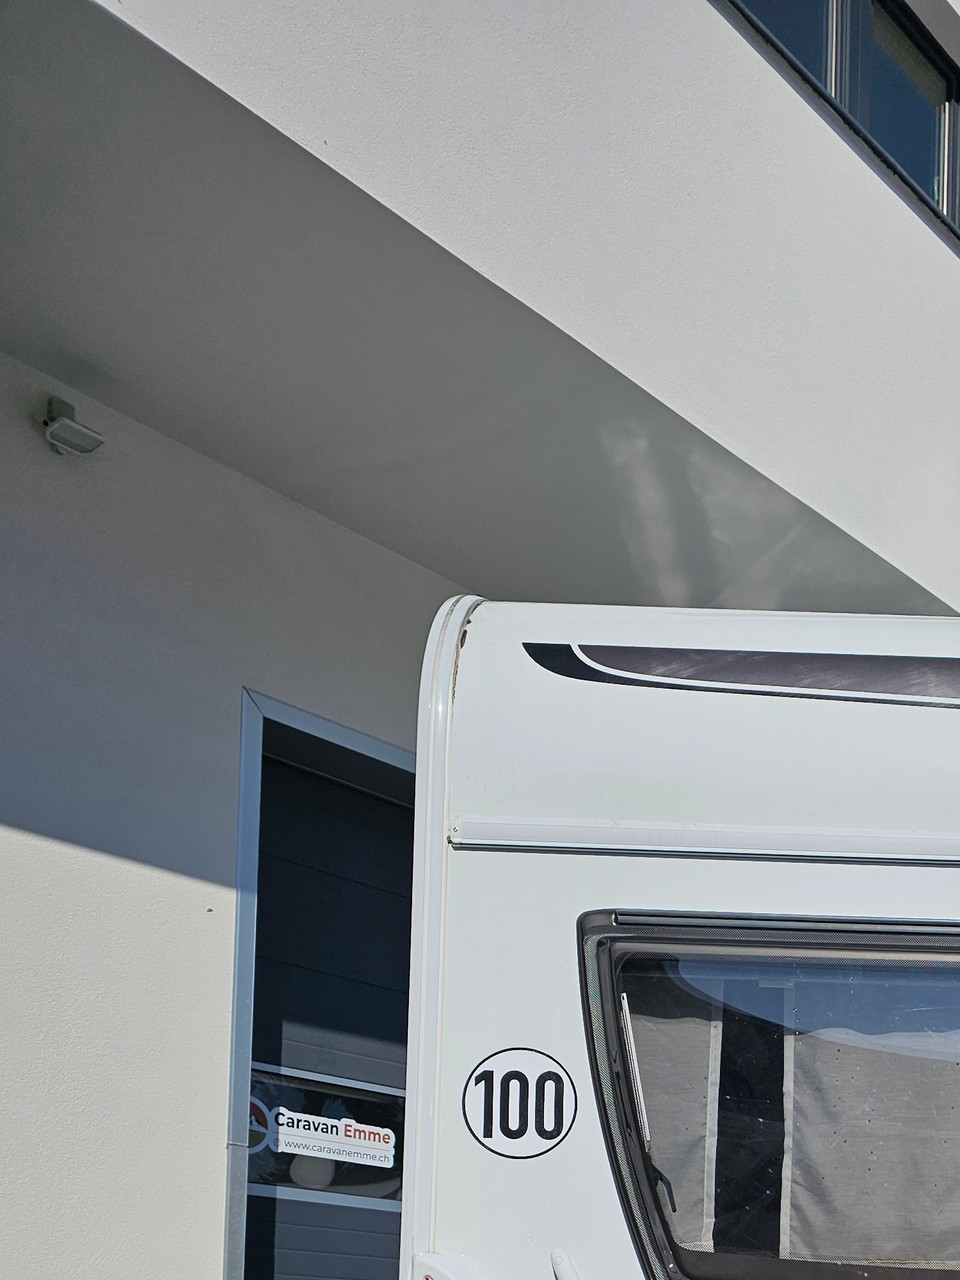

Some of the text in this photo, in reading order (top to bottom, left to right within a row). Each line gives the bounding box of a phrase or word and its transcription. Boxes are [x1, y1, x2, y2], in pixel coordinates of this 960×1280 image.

[474, 1069, 565, 1141] 100
[274, 1112, 391, 1144] Caravan Emme
[283, 1139, 390, 1163] www.caravanemme.ch
